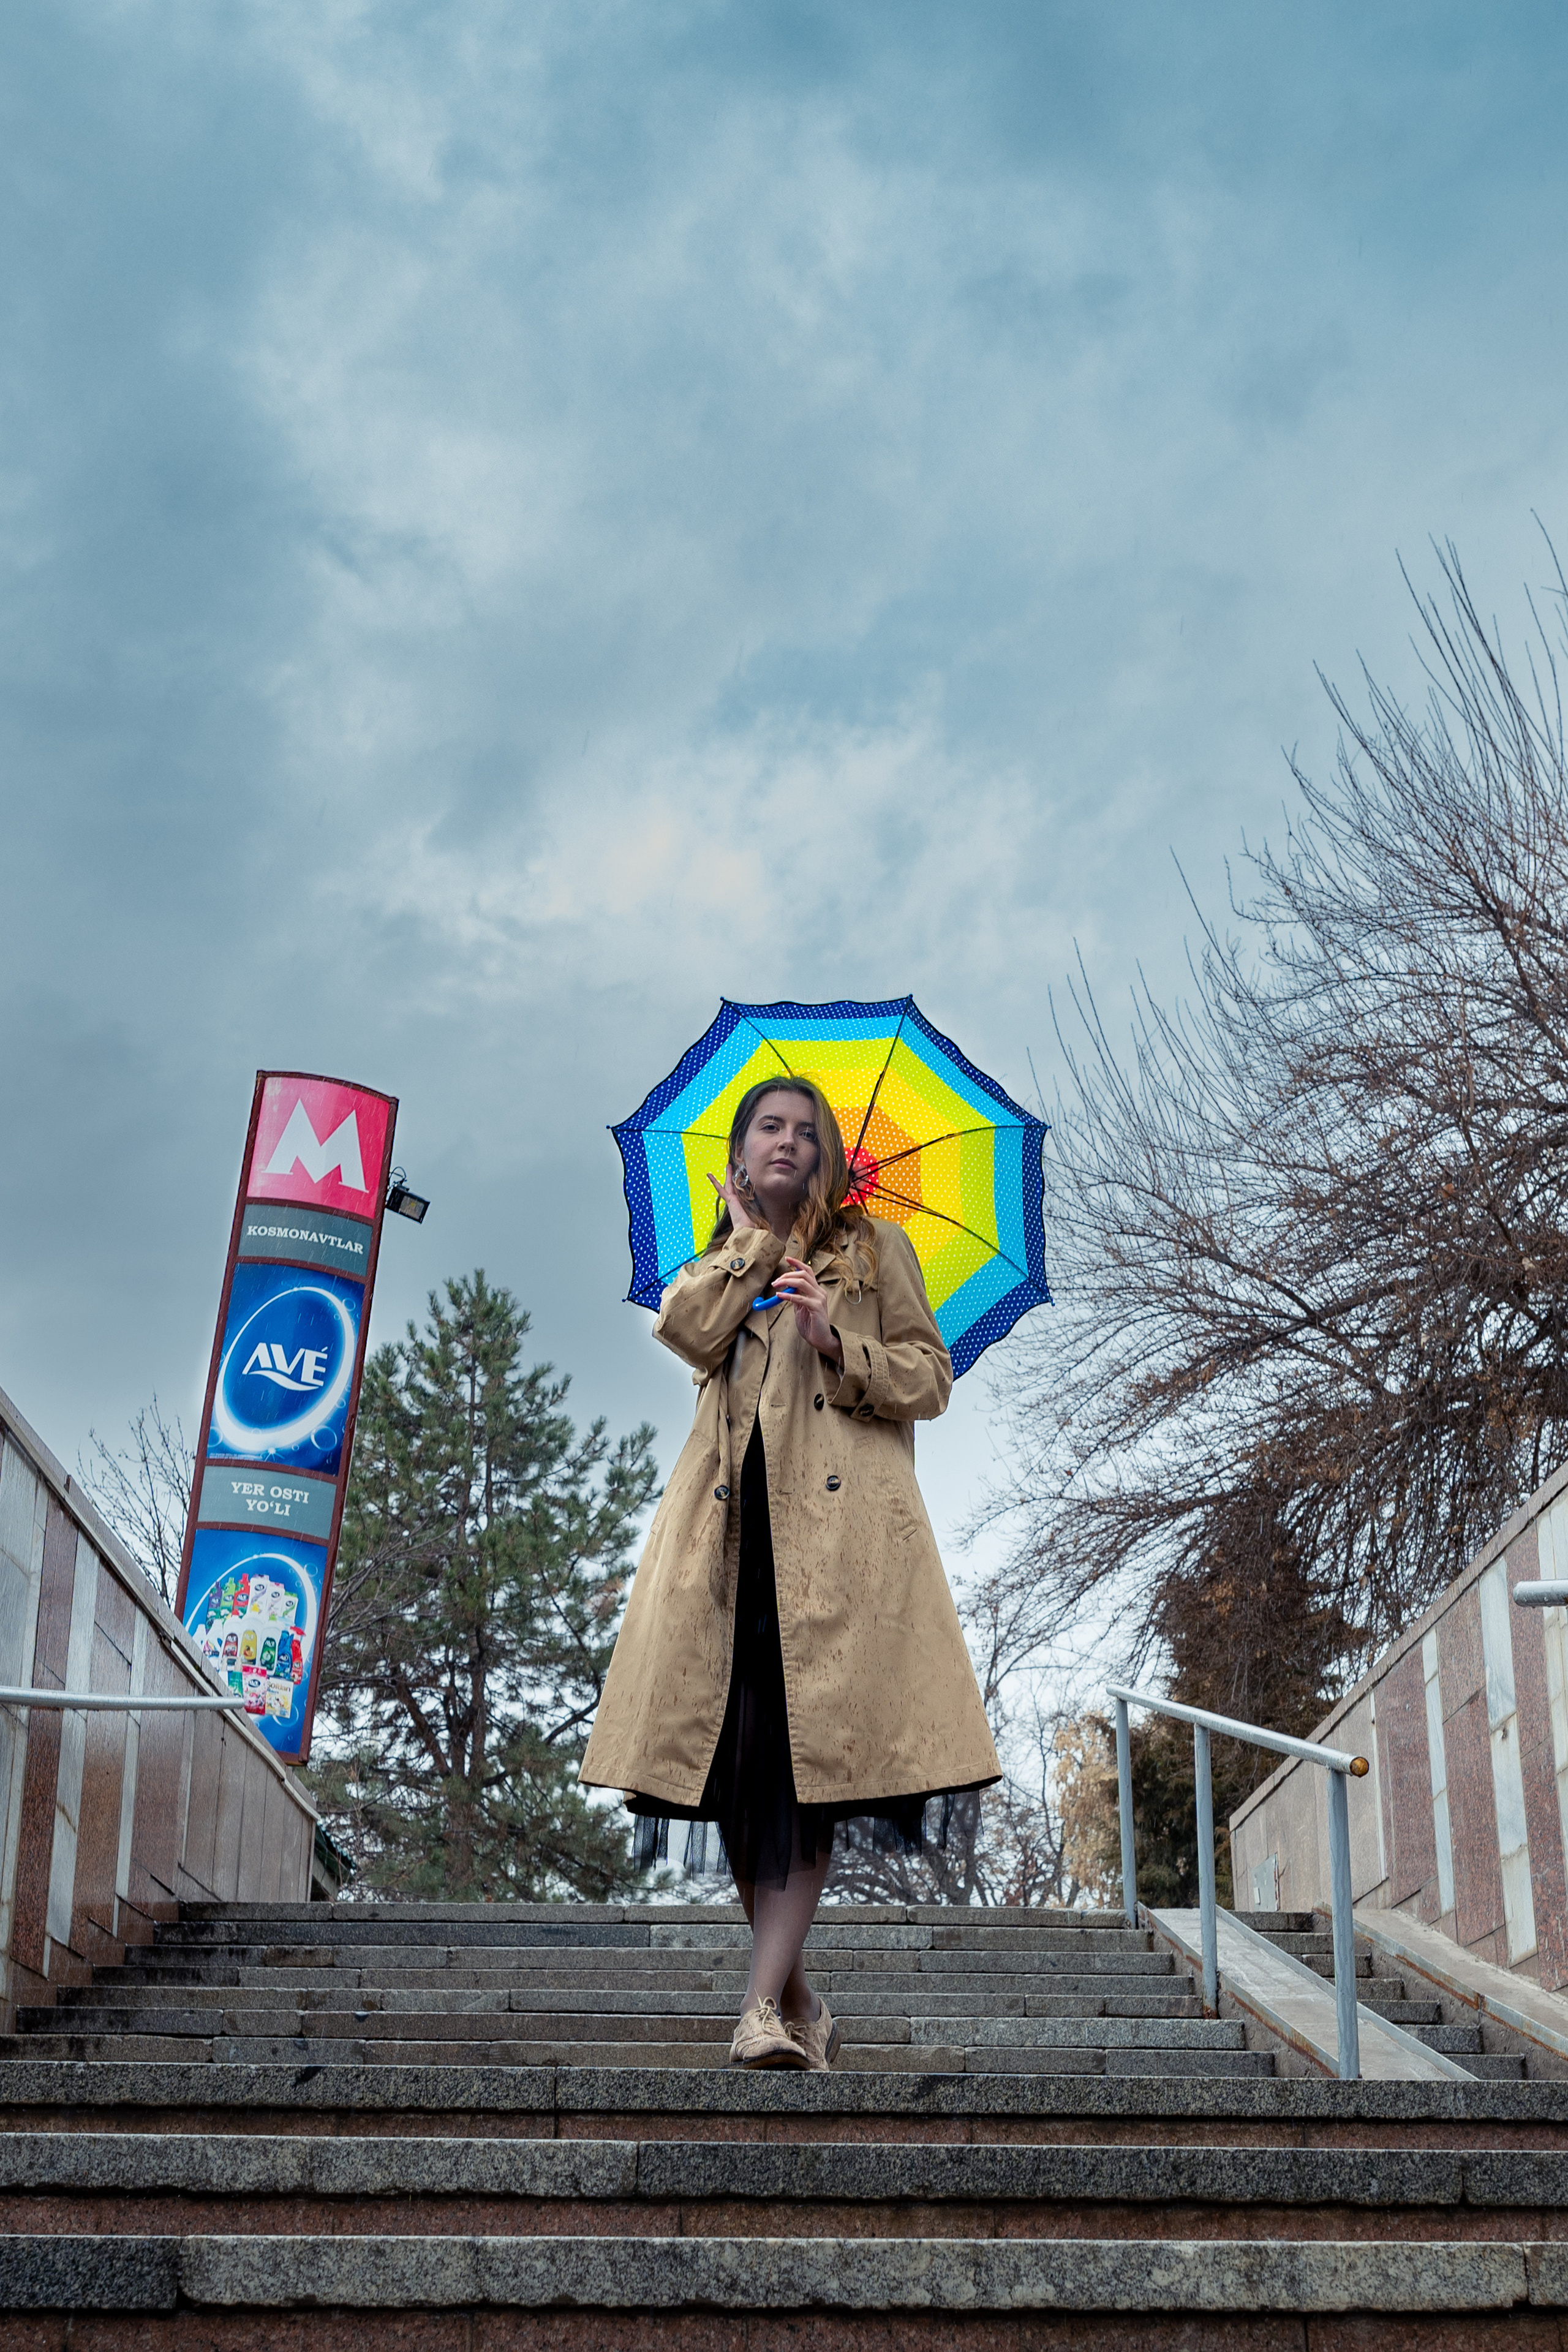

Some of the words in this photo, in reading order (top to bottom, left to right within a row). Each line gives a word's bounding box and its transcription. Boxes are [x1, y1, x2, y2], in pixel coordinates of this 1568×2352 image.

[261, 1098, 369, 1194] M
[247, 1225, 364, 1254] KOSMONAVTLAR
[231, 1482, 265, 1496] YER
[270, 1485, 309, 1504] OSTI
